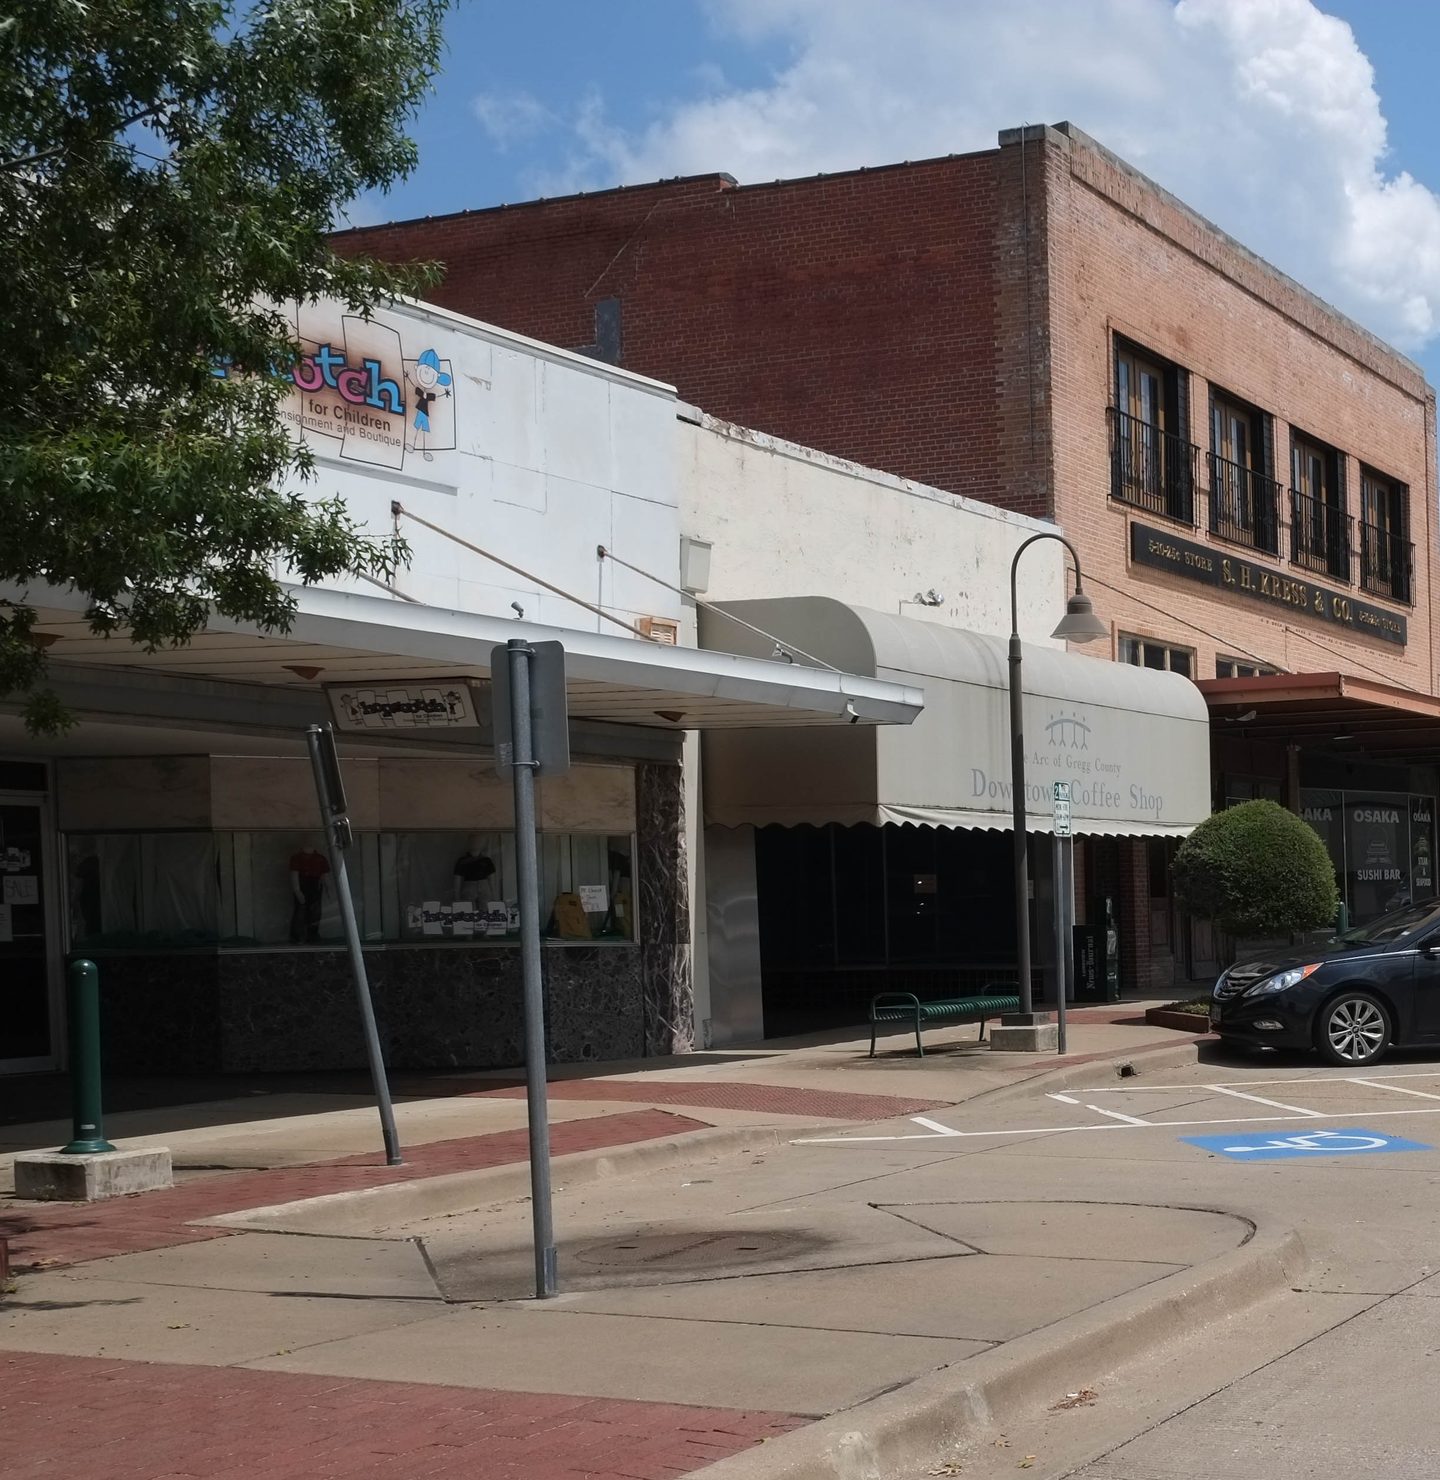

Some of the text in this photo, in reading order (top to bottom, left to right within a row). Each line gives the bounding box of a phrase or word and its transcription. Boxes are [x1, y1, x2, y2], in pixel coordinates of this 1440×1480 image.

[309, 399, 391, 432] for Children
[337, 420, 356, 436] and
[359, 427, 401, 448] Boutique
[1184, 552, 1213, 573] STORE
[1222, 559, 1236, 584] S.
[1240, 564, 1256, 591] H.
[1259, 571, 1308, 607] KRESS
[1314, 591, 1325, 612] &
[1332, 597, 1354, 622] CO.
[1033, 752, 1049, 766] Arc
[1053, 754, 1062, 767] of
[1066, 754, 1091, 774] Gregg
[1095, 758, 1121, 778] County
[970, 768, 1164, 819] Dowtow Coffee Shop
[1353, 810, 1400, 823] OSAKA
[1413, 812, 1431, 823] OSAKA
[1357, 868, 1401, 881] SUSHI BAR
